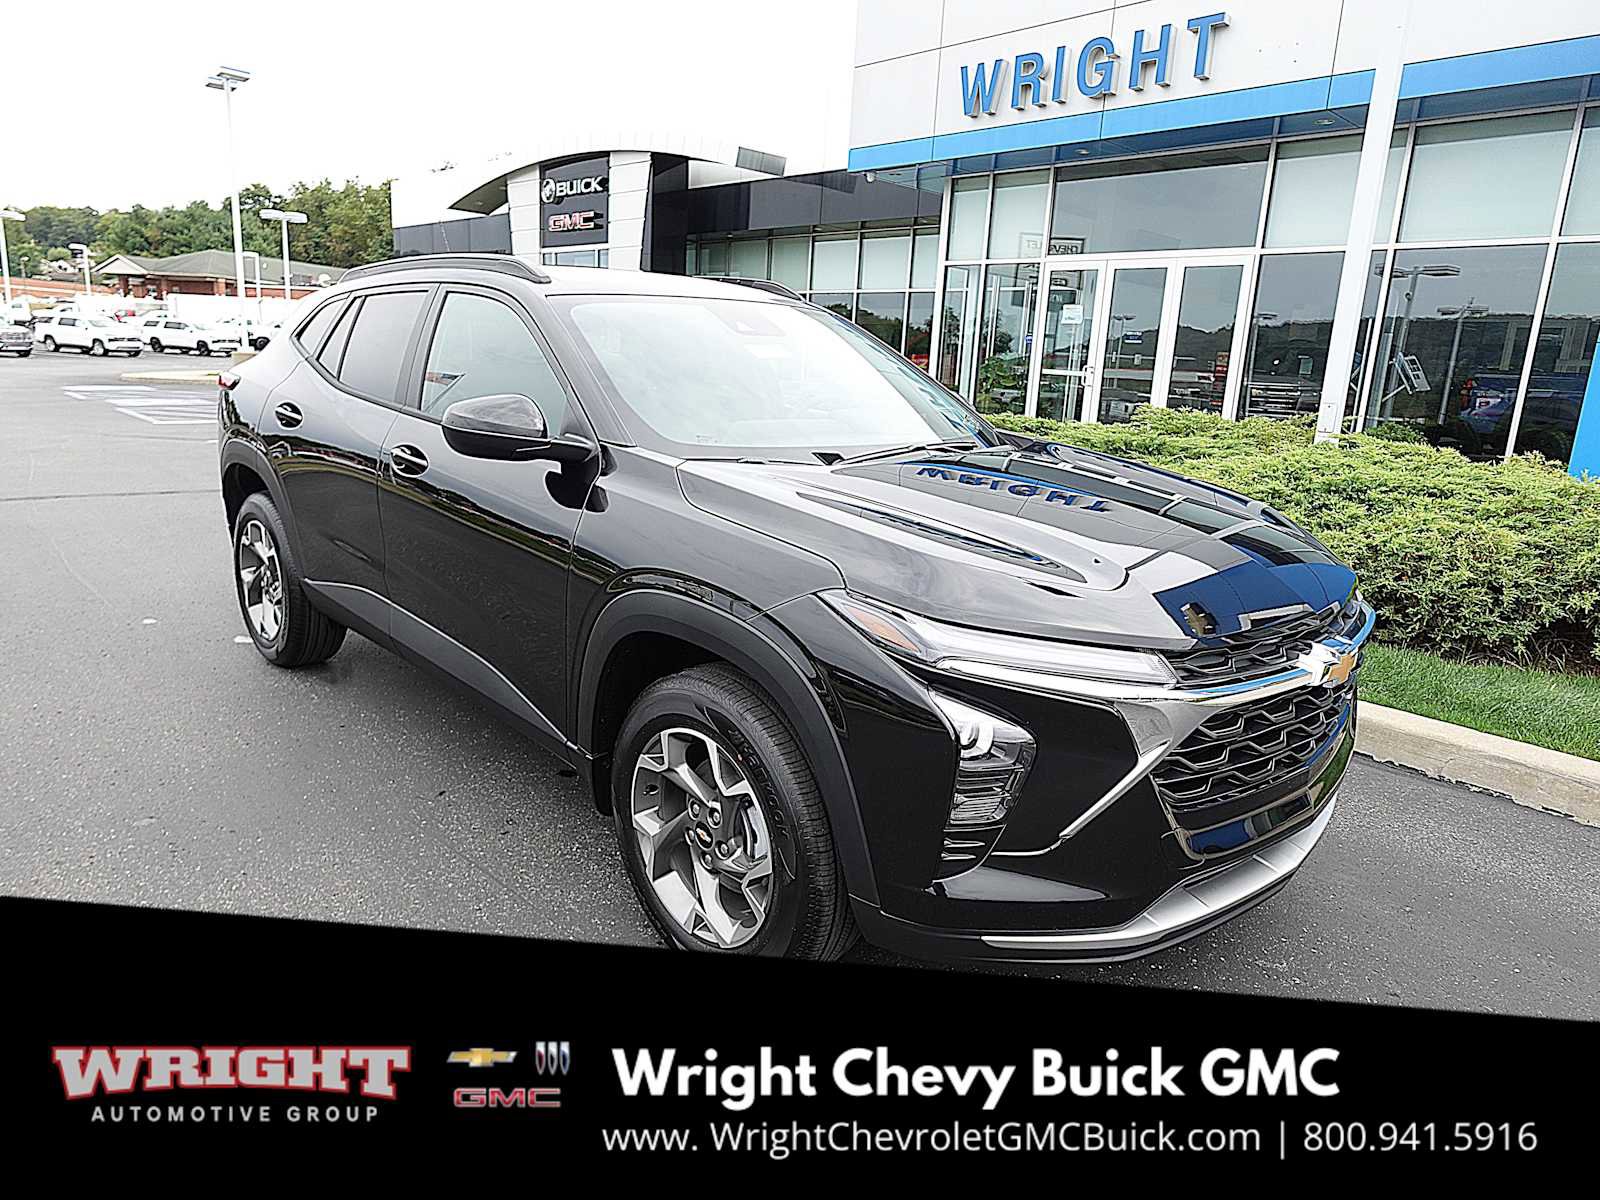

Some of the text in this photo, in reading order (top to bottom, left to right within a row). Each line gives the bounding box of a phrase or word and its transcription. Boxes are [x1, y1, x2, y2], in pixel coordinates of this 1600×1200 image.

[960, 12, 1230, 118] WRIGHT
[556, 176, 603, 197] BUICK
[548, 211, 595, 232] GMC
